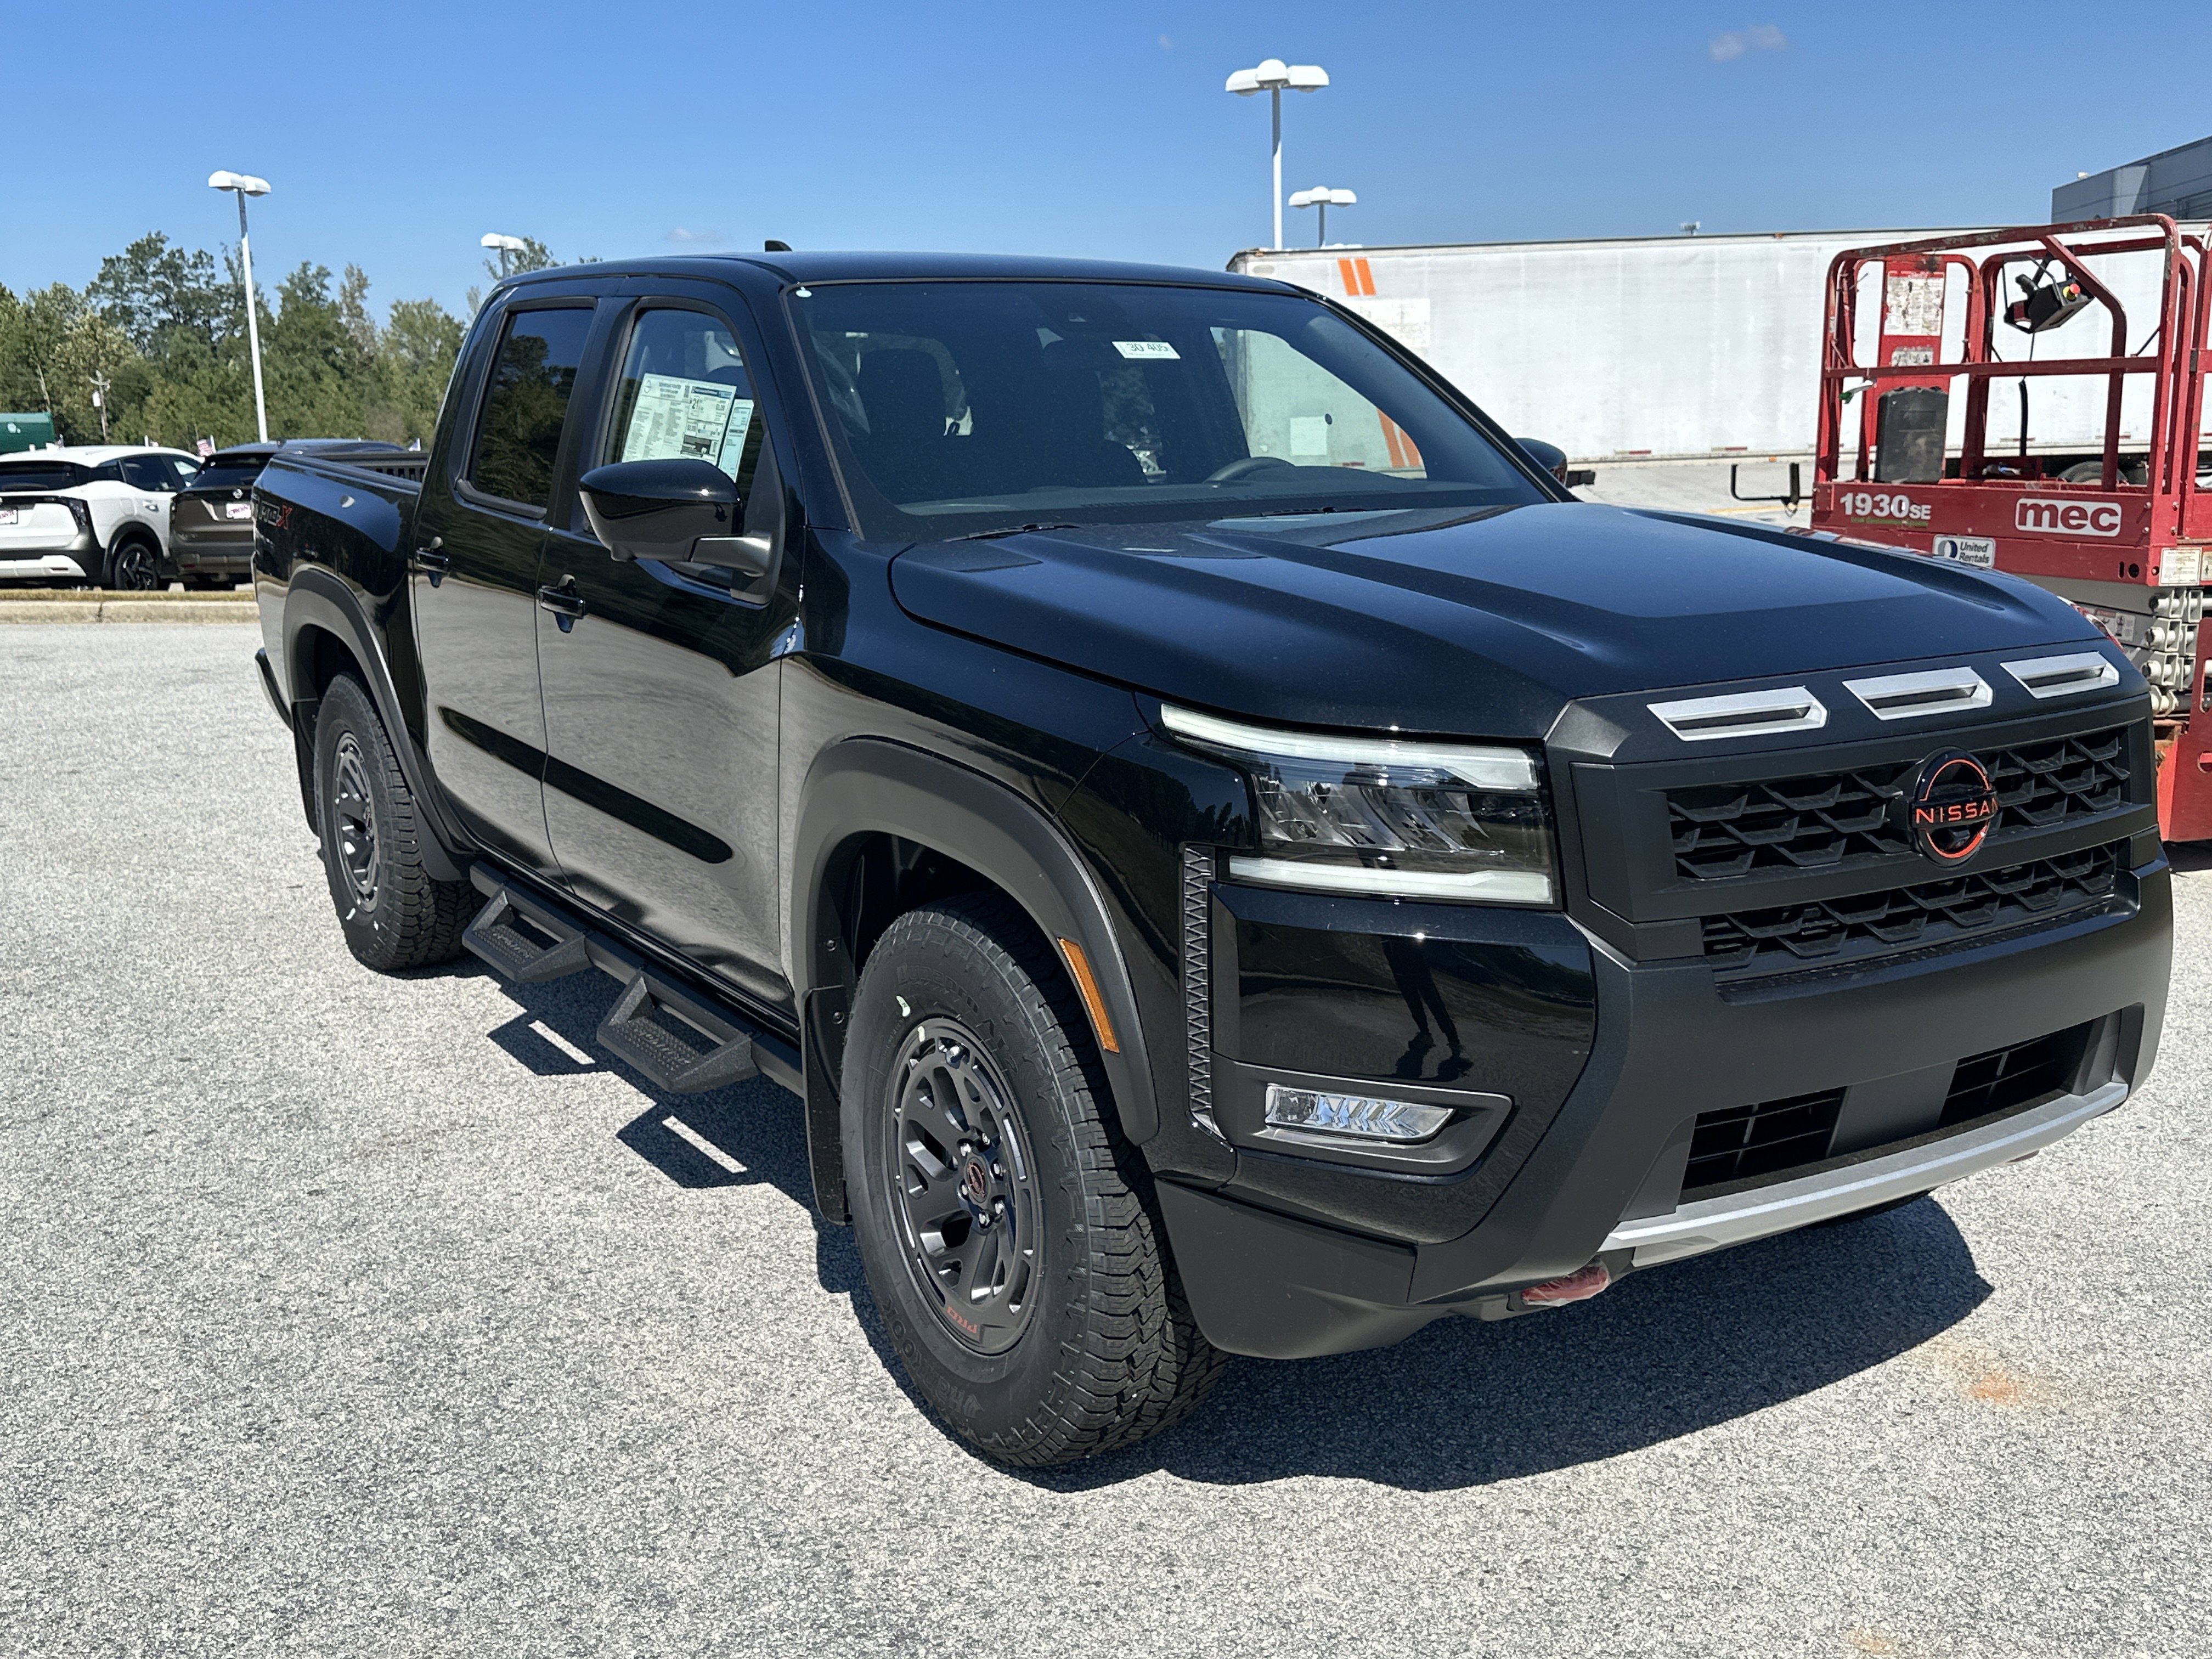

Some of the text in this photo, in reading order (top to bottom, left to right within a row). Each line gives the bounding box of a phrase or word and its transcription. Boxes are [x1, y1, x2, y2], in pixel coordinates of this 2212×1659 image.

[2018, 503, 2119, 532] mec
[1960, 541, 1989, 552] United
[1958, 552, 1990, 564] Rentals
